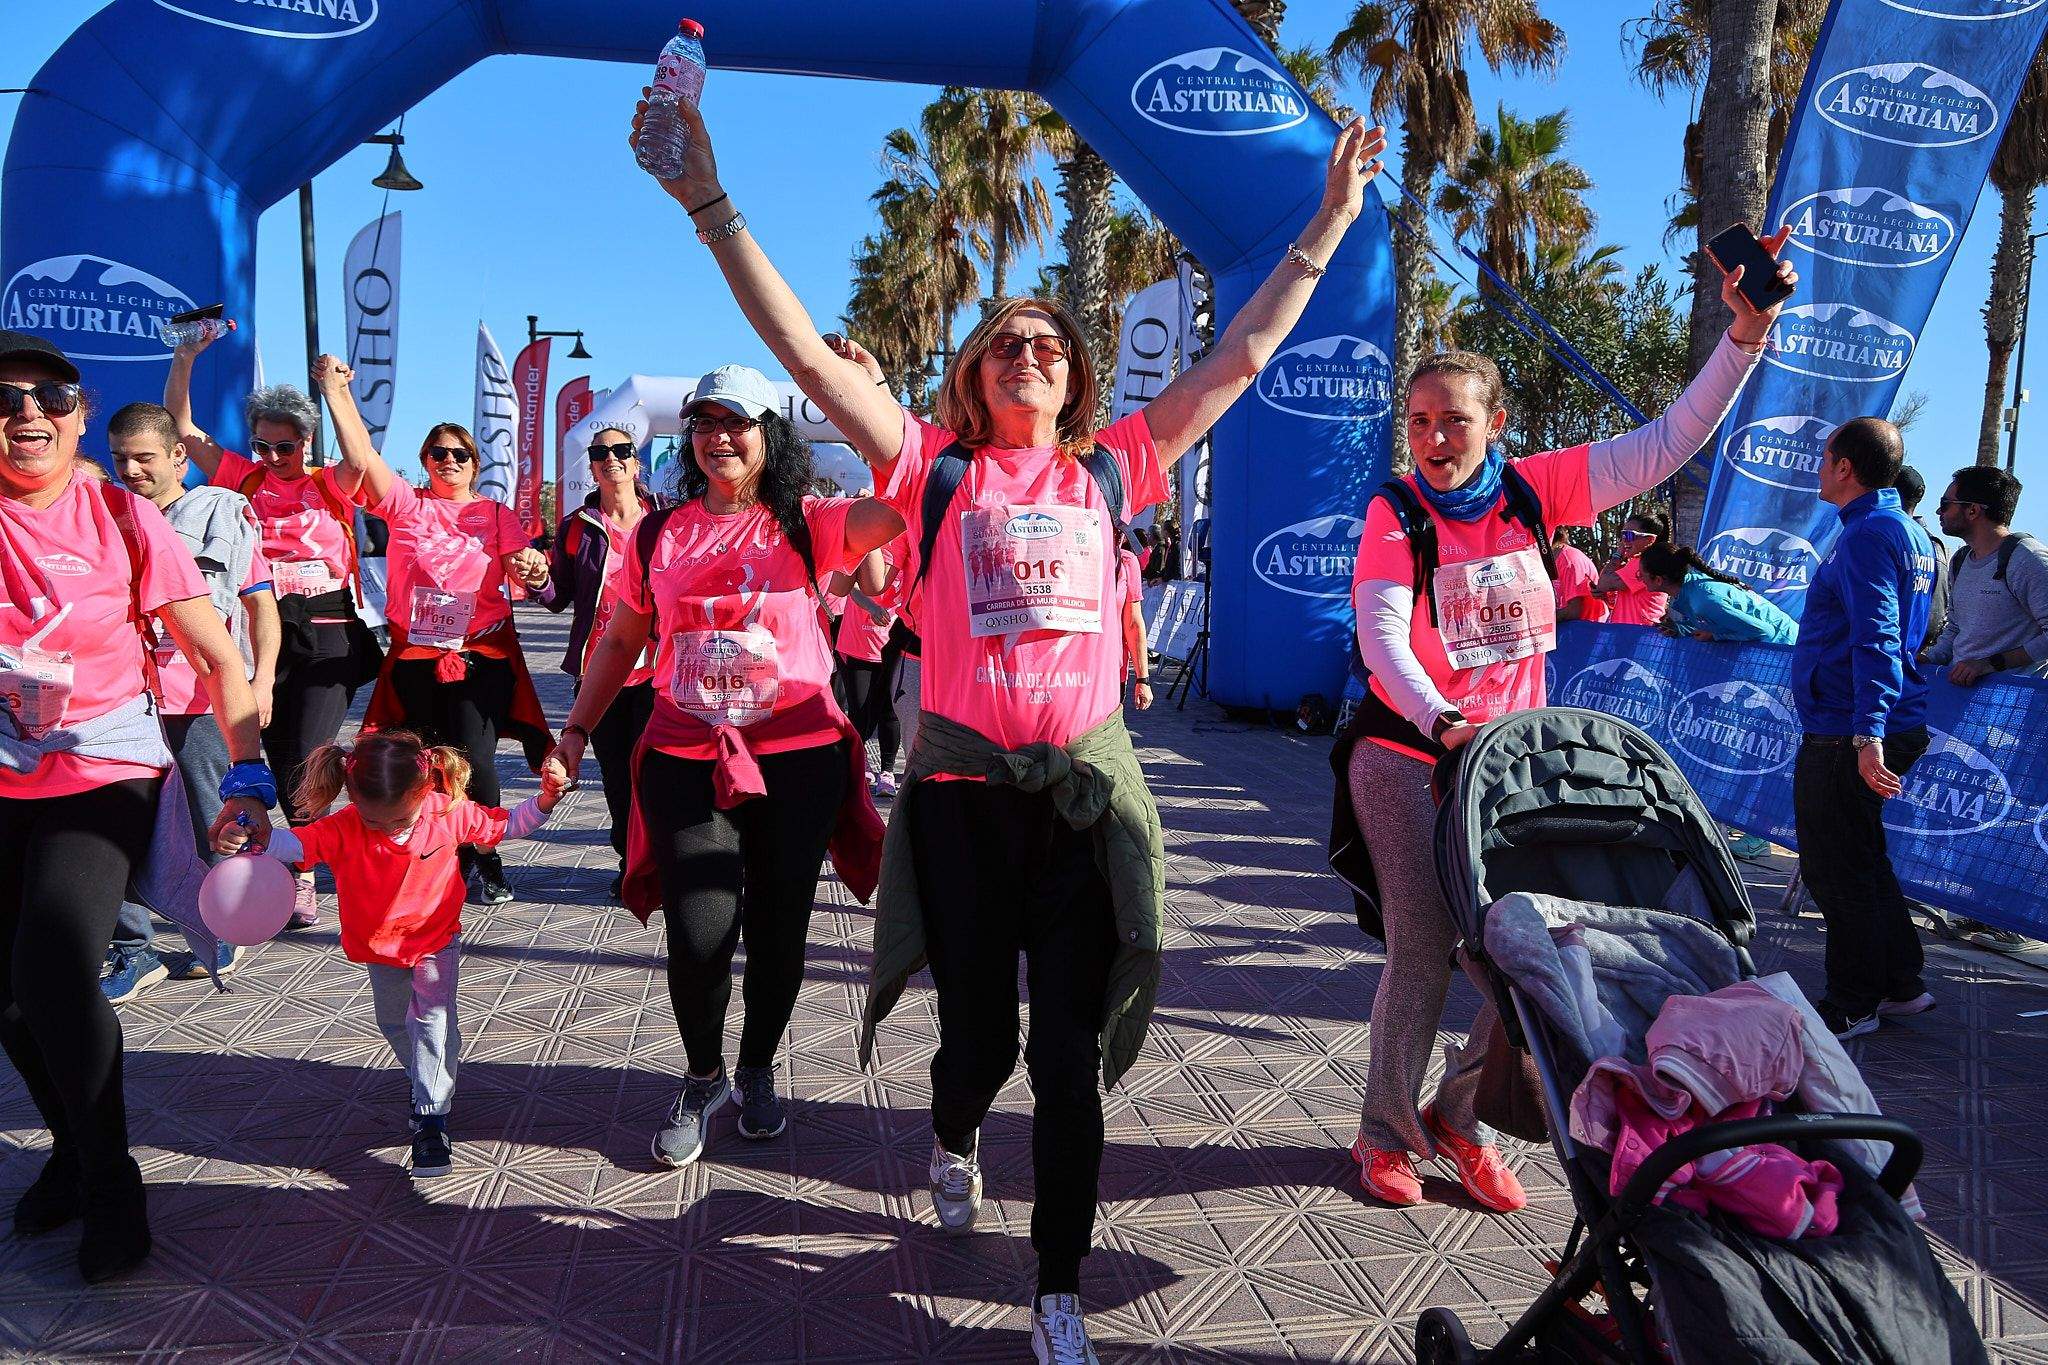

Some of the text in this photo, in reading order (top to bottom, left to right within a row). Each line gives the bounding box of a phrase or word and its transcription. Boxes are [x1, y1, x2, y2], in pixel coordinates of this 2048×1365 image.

[1176, 75, 1237, 85] CENTRAL
[1145, 78, 1301, 116] ASTURIANA
[1825, 82, 1979, 134] ASTURIANA
[1861, 83, 1981, 110] CENTRAL LECHERA
[1791, 206, 1939, 253] ASTURIANA
[1824, 207, 1940, 230] CENTRAL LECHERA
[28, 288, 185, 314] CENTRAL LECHERA
[7, 291, 172, 339] ASTURIAN
[1767, 322, 1903, 368] ASTURIANA
[1792, 323, 1905, 347] CENTRAL LECHERA
[354, 268, 392, 446] YSHO
[1296, 364, 1351, 373] CENTRAL
[1268, 366, 1391, 400] ASTURIANA
[521, 365, 540, 452] Santander
[1760, 435, 1810, 450] CENTRAL
[1009, 521, 1059, 534] ASTURIANA
[1292, 543, 1347, 552] CENTRAL
[1013, 559, 1064, 581] 016
[1026, 585, 1052, 595] 3538
[986, 601, 1016, 611] CARRERA
[1479, 600, 1524, 623] 016
[432, 613, 455, 626] 016
[1489, 625, 1511, 635] 2595
[1456, 650, 1492, 663] OYSHO
[702, 675, 745, 691] 016
[1027, 672, 1044, 688] DE
[1048, 672, 1062, 688] LA
[1675, 702, 1783, 763] ASTURIANA
[1917, 763, 1989, 787] LECHERA
